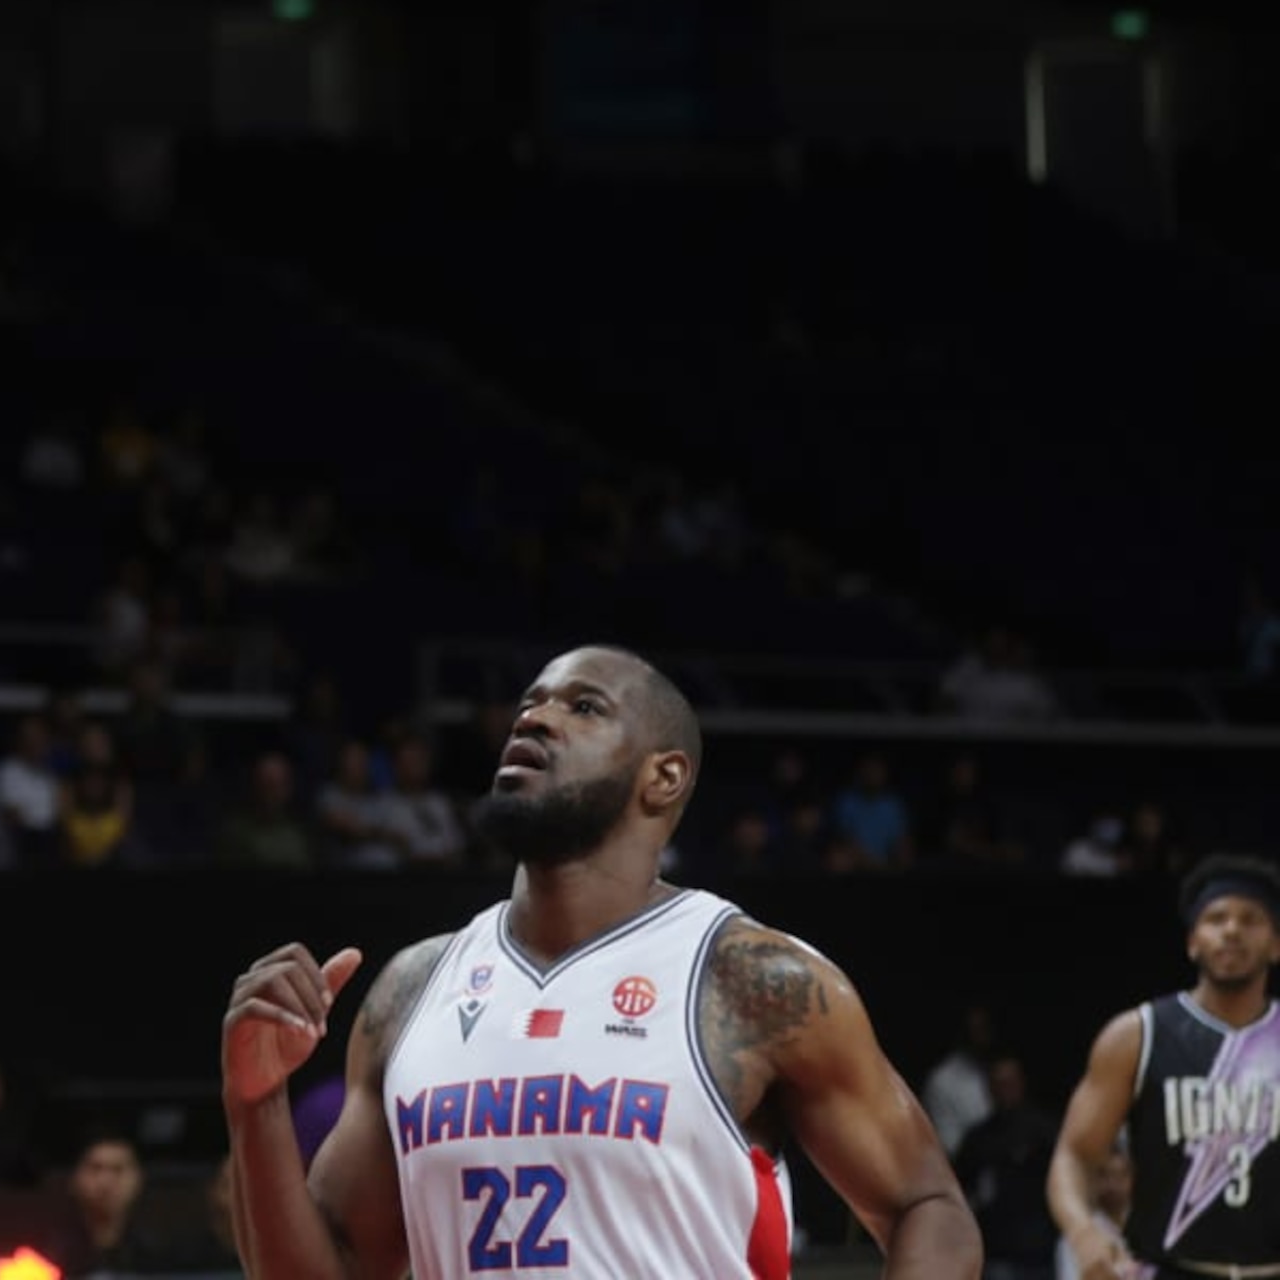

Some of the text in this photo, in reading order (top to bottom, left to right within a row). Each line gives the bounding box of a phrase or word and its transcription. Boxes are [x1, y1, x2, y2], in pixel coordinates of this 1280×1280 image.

[396, 1072, 670, 1156] MANAMA
[1223, 1141, 1251, 1208] 3
[462, 1163, 569, 1272] 22
